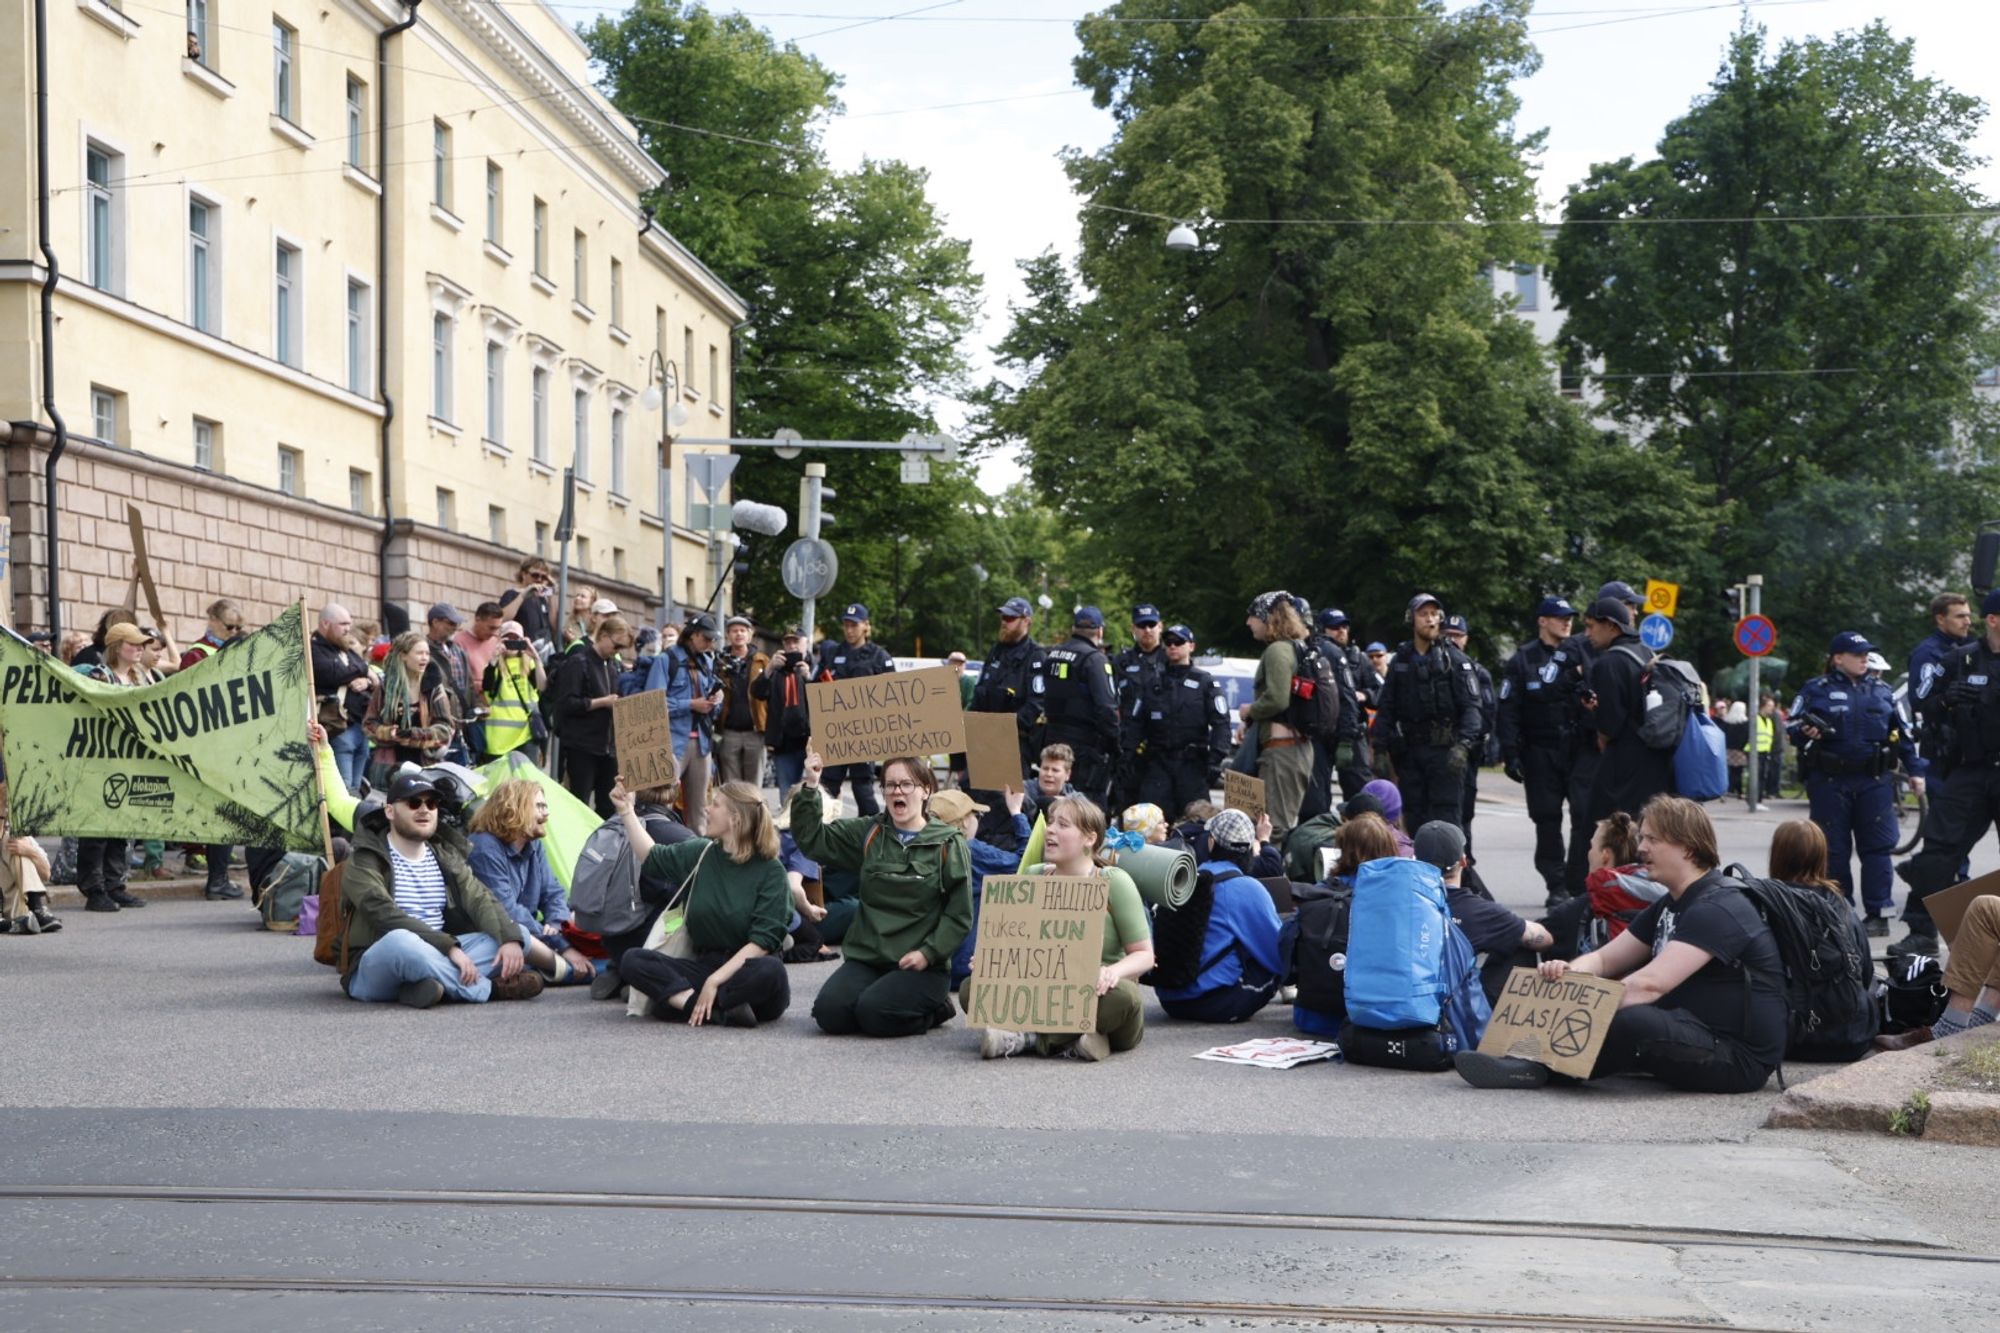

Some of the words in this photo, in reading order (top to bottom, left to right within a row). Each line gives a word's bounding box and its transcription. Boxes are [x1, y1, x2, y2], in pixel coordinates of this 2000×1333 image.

[140, 670, 276, 744] SUOMEN
[818, 677, 926, 713] LAJIKATO
[931, 687, 947, 696] =
[825, 713, 923, 739] OIKEUDEN-
[825, 730, 953, 760] MUKAISUUSKATO
[624, 748, 674, 788] ALAS
[985, 880, 1036, 905] MIKSI
[1041, 881, 1108, 912] HALLITUS
[982, 912, 1031, 940] tukee,
[1039, 919, 1086, 941] KUN
[979, 944, 1068, 980] IHMISIÄ
[973, 983, 1096, 1030] KUOLEE?
[1507, 972, 1611, 1010] LENTOTUET
[1495, 1003, 1561, 1036] ALAS!
